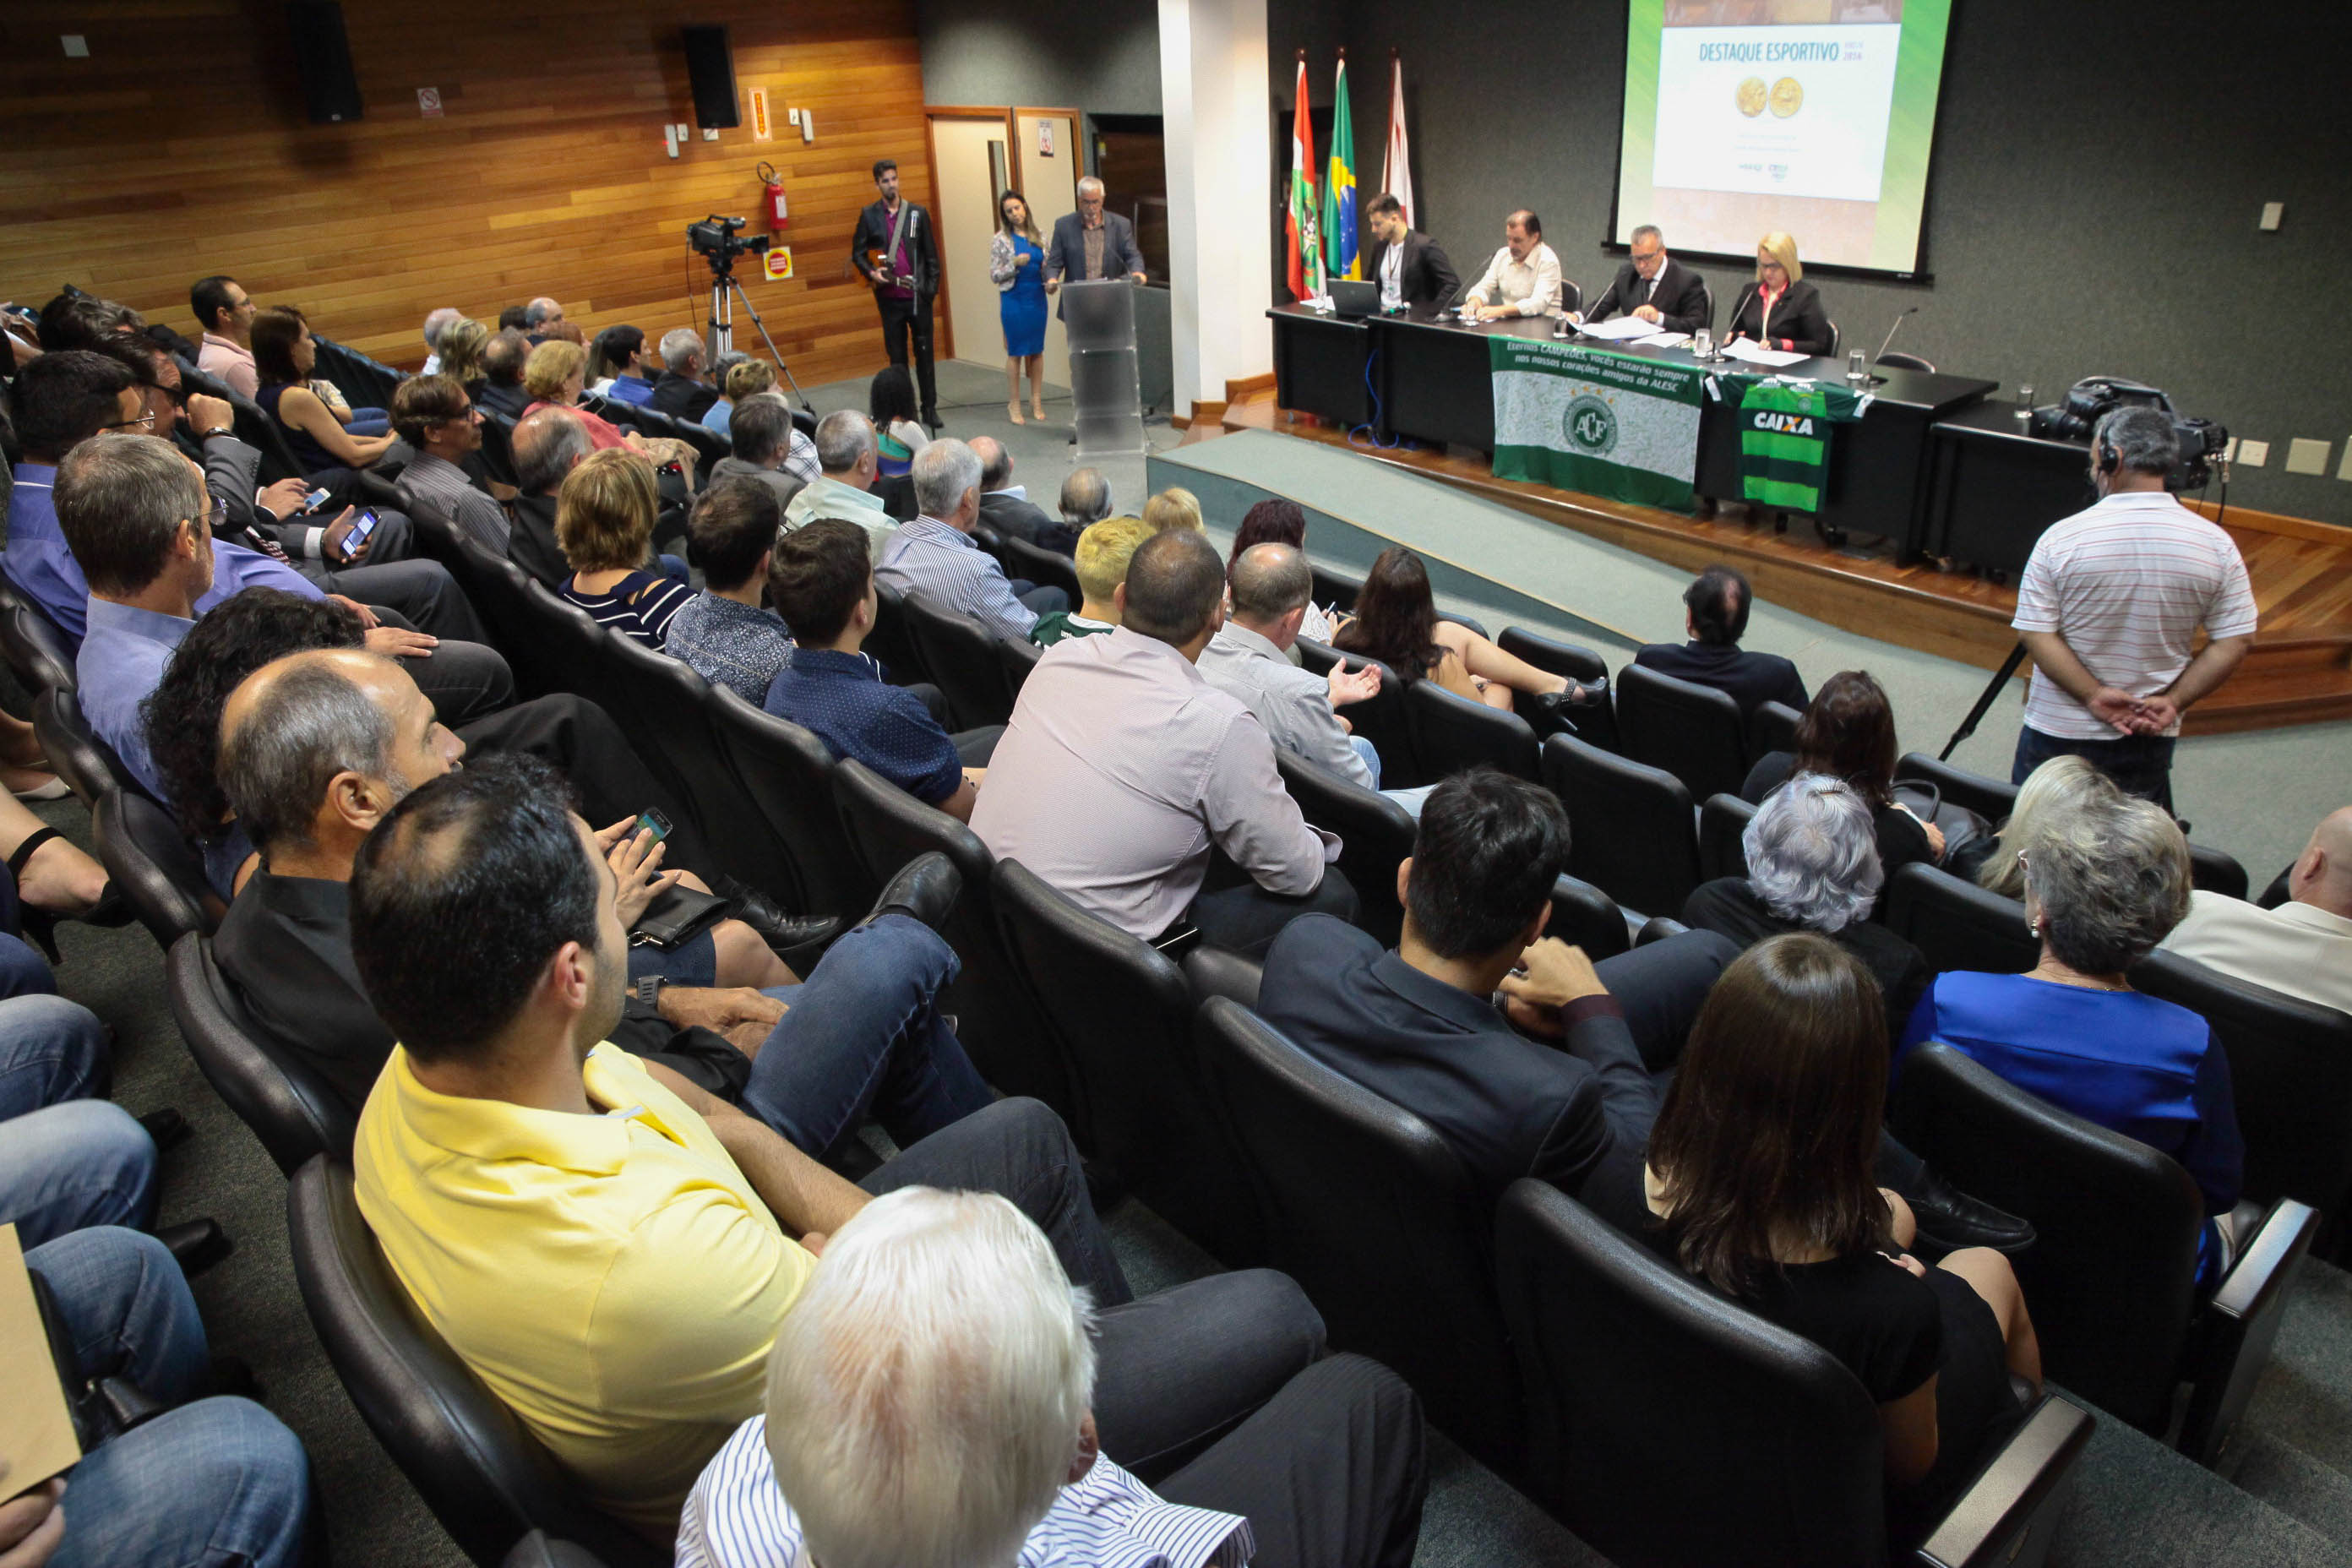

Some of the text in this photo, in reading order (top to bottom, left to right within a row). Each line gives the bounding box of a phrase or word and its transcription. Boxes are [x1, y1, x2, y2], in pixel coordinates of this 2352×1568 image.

[1699, 42, 1839, 63] DESTAQUE ESPORTIVO
[1507, 341, 1538, 351] Eternos
[1590, 353, 1614, 367] vocês
[1616, 361, 1652, 375] estarão
[1654, 368, 1690, 382] sempre
[1532, 356, 1560, 368] nossos
[1562, 361, 1600, 374] corações
[1602, 369, 1634, 384] amigos
[1636, 377, 1649, 385] da
[1650, 379, 1679, 392] ALESC
[1754, 412, 1813, 435] CAIXA
